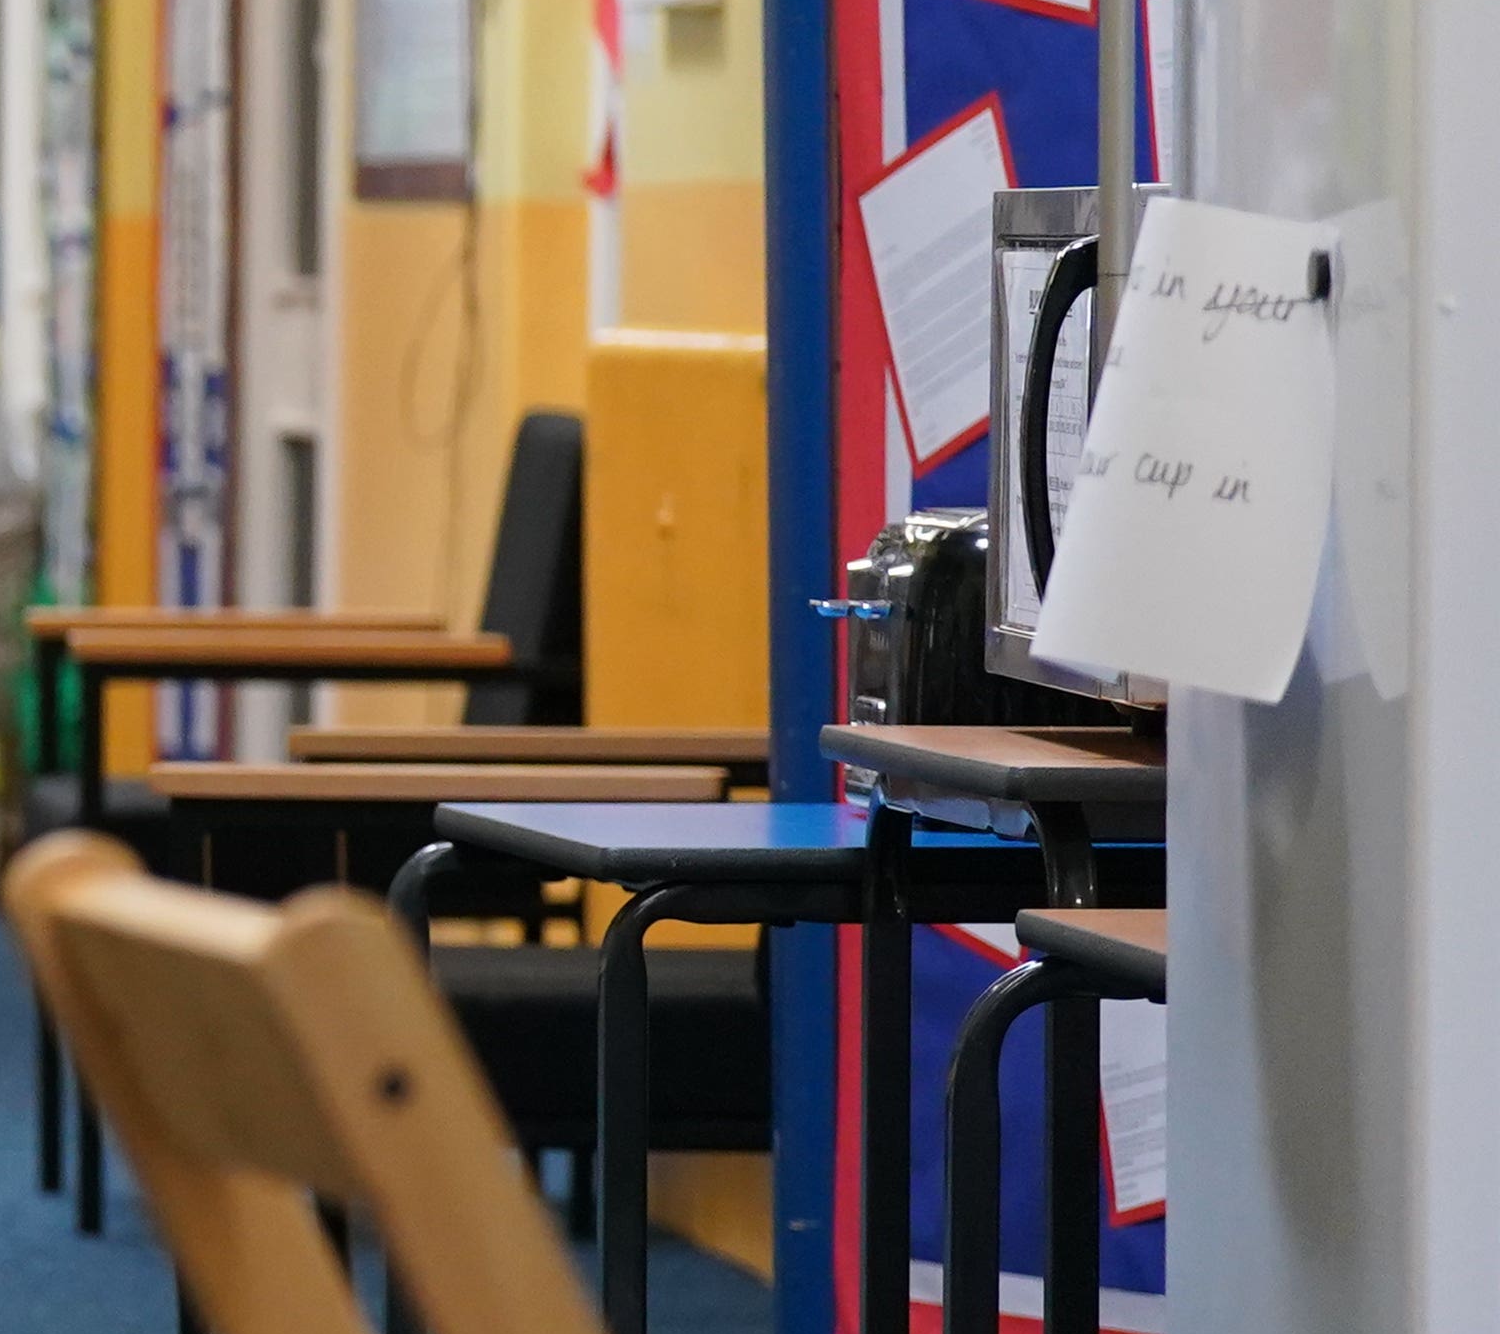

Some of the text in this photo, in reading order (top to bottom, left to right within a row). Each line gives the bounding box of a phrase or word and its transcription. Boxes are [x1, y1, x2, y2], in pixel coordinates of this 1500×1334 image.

[1149, 254, 1186, 300] in
[1133, 452, 1194, 500] cup
[1212, 461, 1251, 503] in
